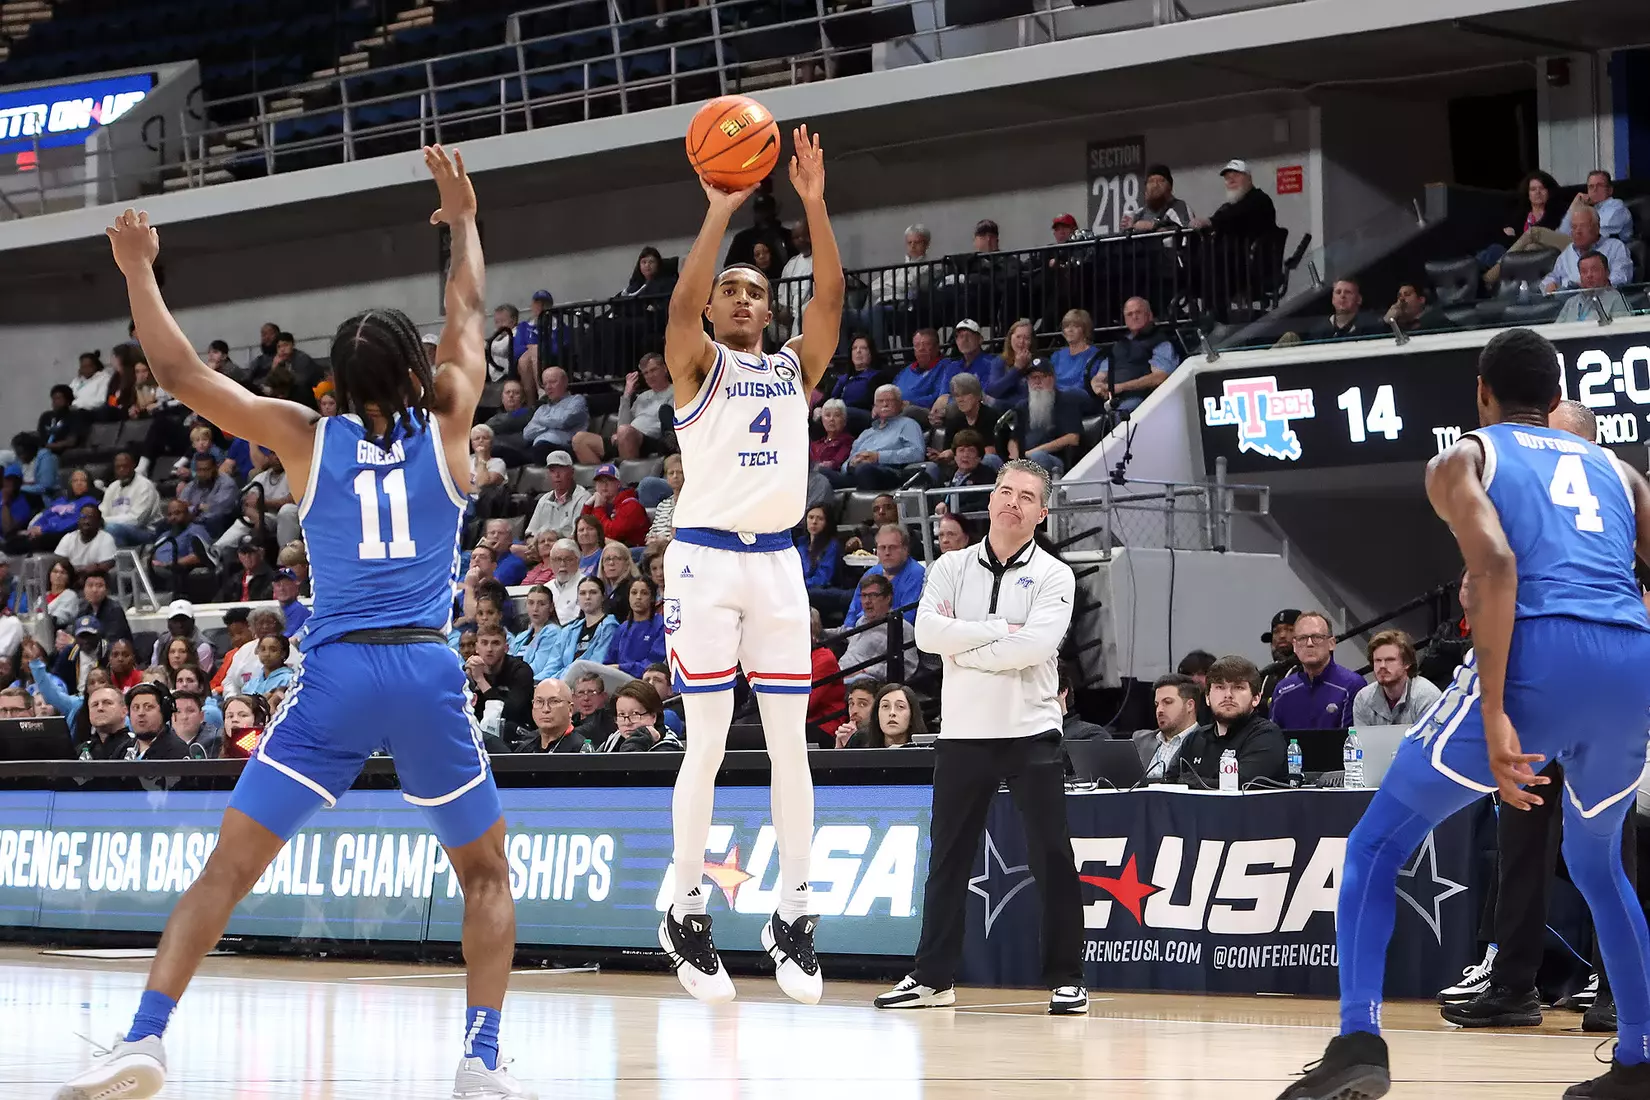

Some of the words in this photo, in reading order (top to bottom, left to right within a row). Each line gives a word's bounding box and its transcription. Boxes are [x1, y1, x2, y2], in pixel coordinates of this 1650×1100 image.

[1090, 144, 1140, 169] SECTION
[1092, 173, 1139, 236] 218
[749, 406, 772, 444] 4
[1337, 384, 1403, 443] 14
[1595, 412, 1639, 444] RIOD
[356, 439, 406, 465] GREEN
[738, 450, 778, 466] TECH
[353, 468, 417, 560] 11
[1549, 454, 1604, 533] 4
[88, 832, 142, 891] USA
